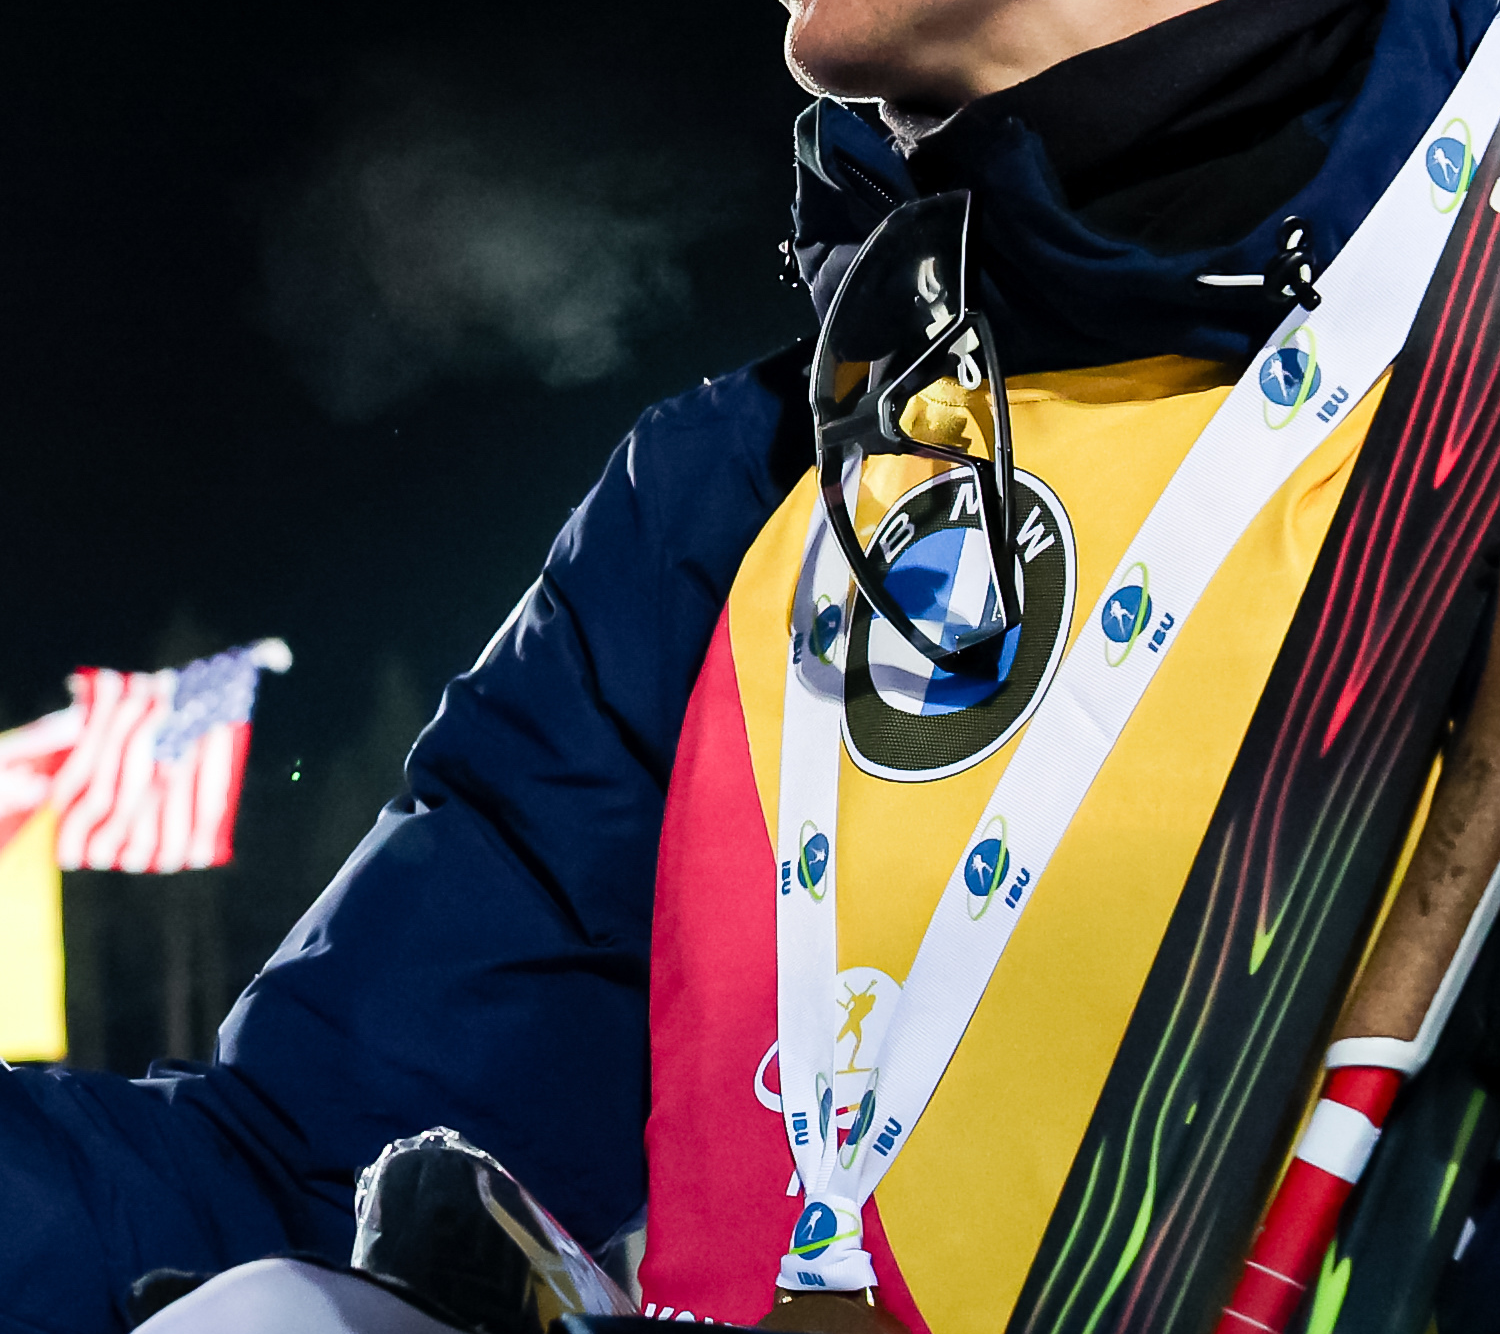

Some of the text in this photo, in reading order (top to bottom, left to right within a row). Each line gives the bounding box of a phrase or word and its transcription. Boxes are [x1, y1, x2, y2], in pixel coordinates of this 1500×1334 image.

[1315, 385, 1350, 425] IBU
[1147, 611, 1177, 655] IBU
[780, 860, 792, 896] IBU
[1004, 867, 1031, 910] IBU
[791, 1111, 809, 1146] IBU
[872, 1116, 903, 1157] IBU
